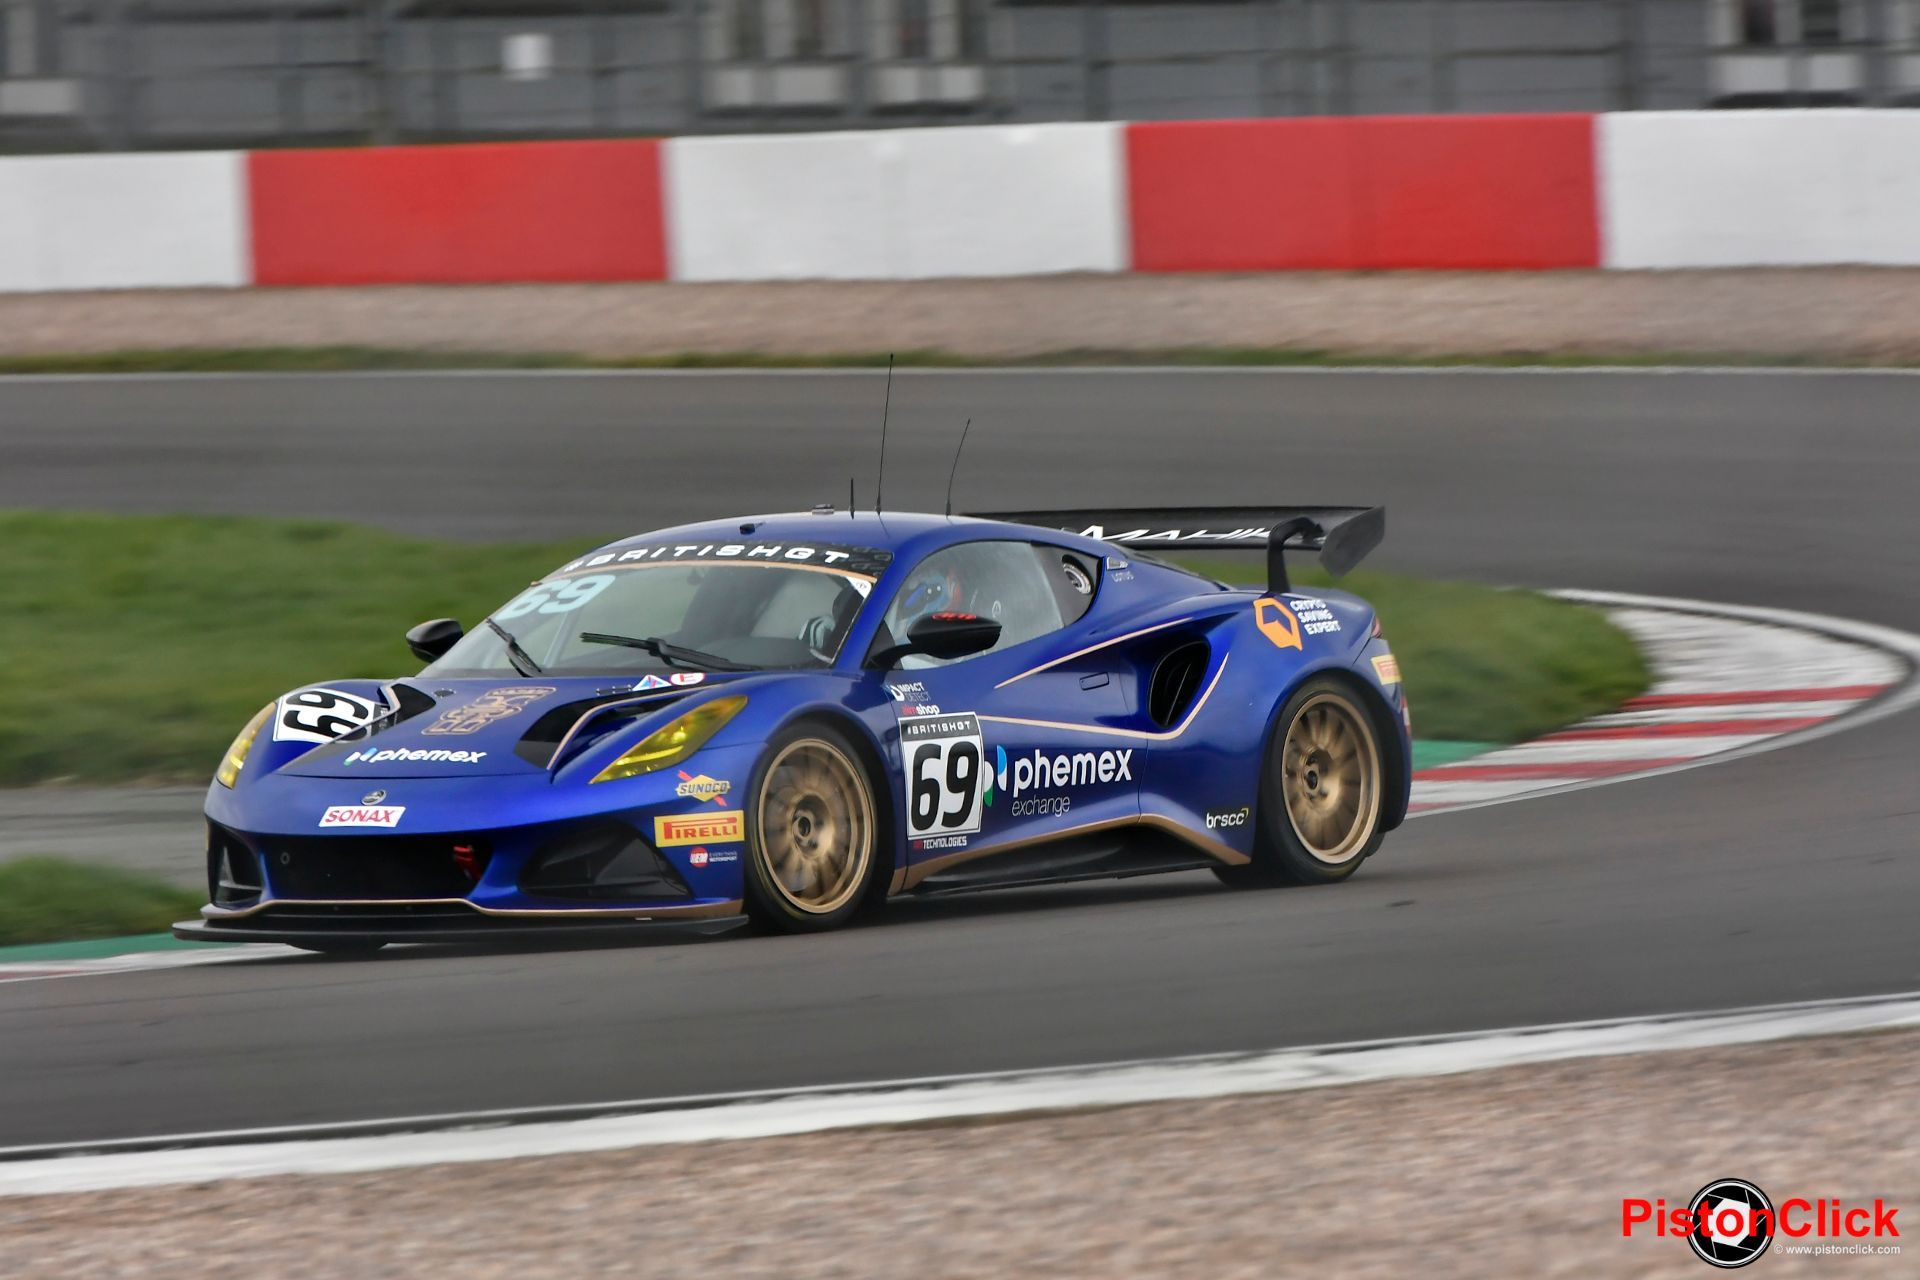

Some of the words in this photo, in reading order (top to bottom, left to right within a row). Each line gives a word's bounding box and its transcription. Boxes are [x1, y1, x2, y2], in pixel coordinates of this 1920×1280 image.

[494, 575, 616, 621] 69
[372, 747, 488, 764] phemex
[1013, 747, 1133, 798] phemex
[679, 782, 728, 795] SUNOCO
[910, 740, 979, 832] 69
[325, 809, 395, 824] SONAX
[1011, 796, 1071, 818] exchange
[663, 816, 738, 840] PIRELLI
[1206, 811, 1245, 829] brscc
[923, 835, 967, 850] TECHNOLOGIES
